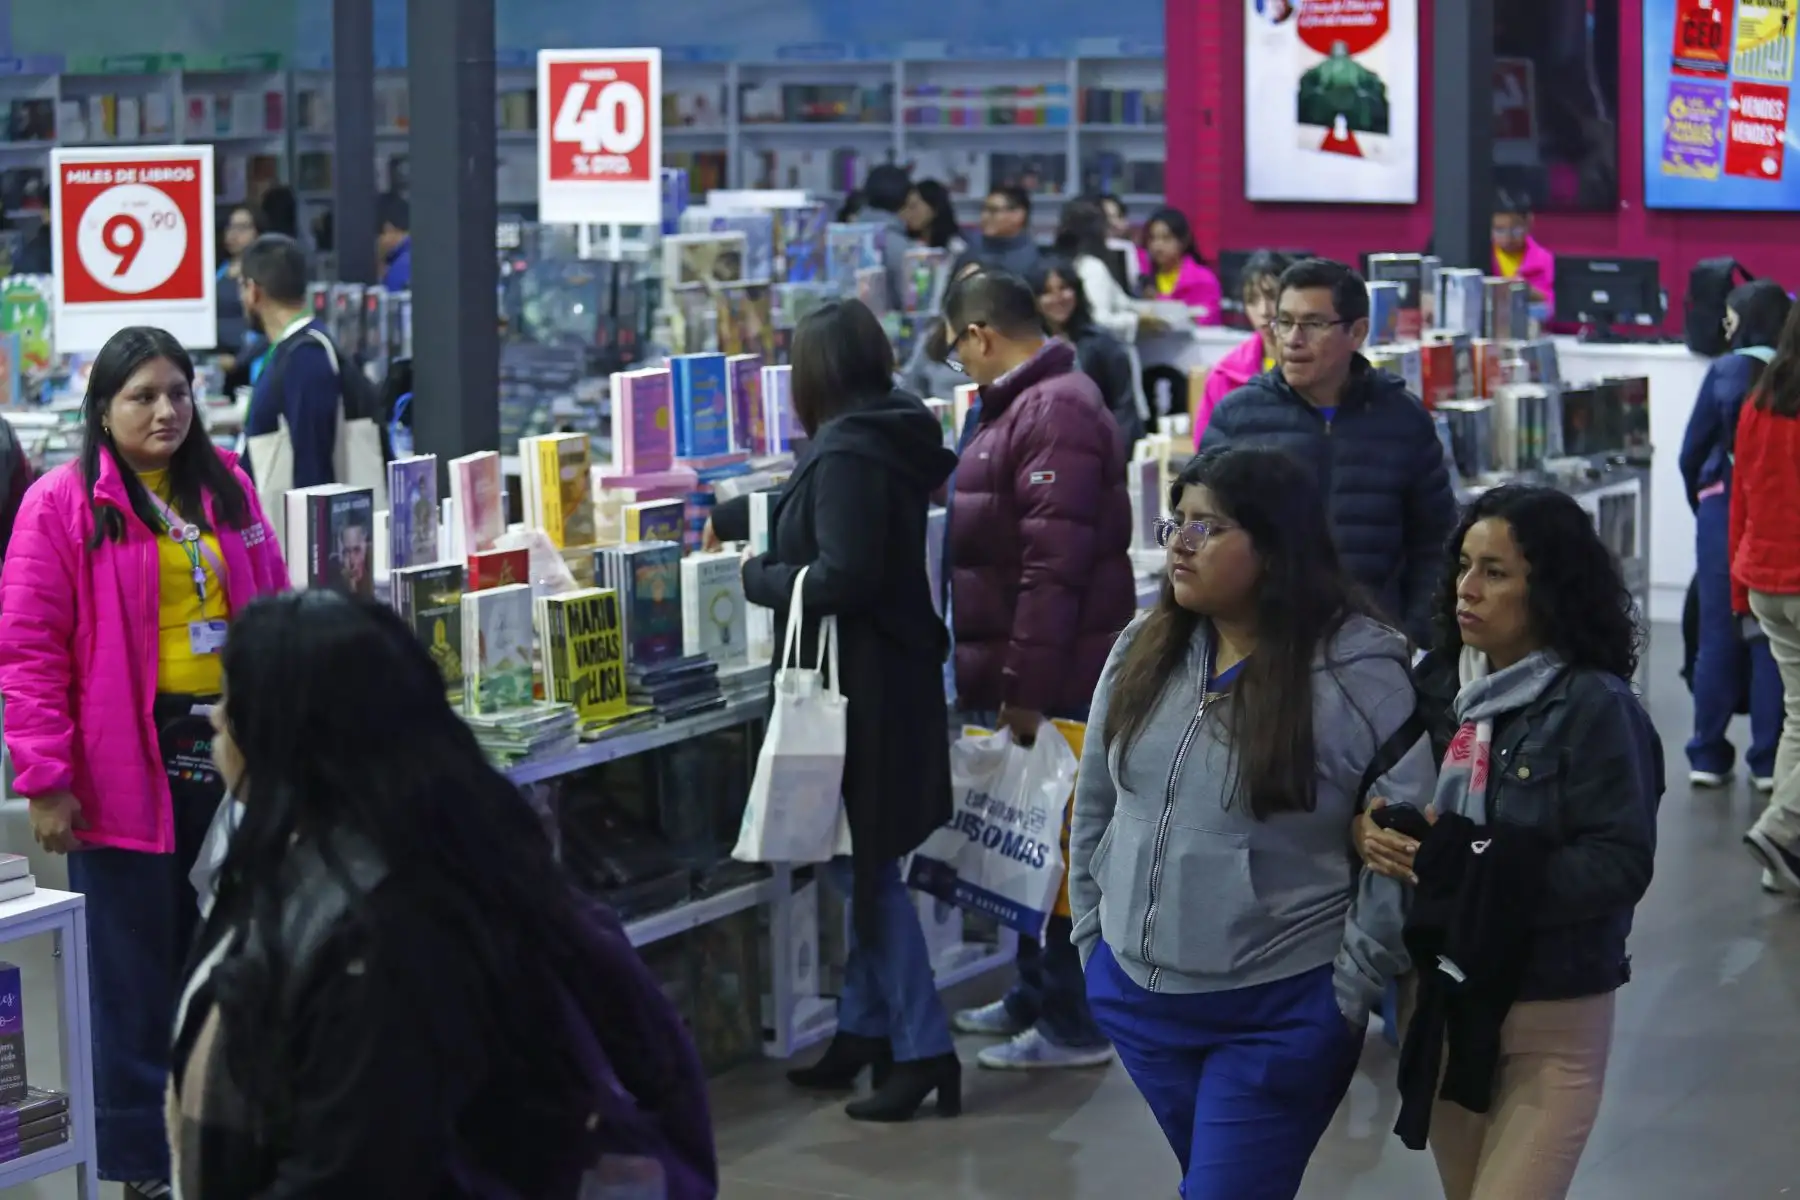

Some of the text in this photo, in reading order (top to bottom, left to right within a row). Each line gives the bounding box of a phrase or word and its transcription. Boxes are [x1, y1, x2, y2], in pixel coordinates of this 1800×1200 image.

[1683, 21, 1723, 49] CEO
[553, 80, 645, 154] 40
[66, 166, 196, 184] MILES DE LIBROS
[102, 213, 144, 276] 9
[567, 595, 616, 639] MARIO
[574, 633, 620, 669] VARGAS
